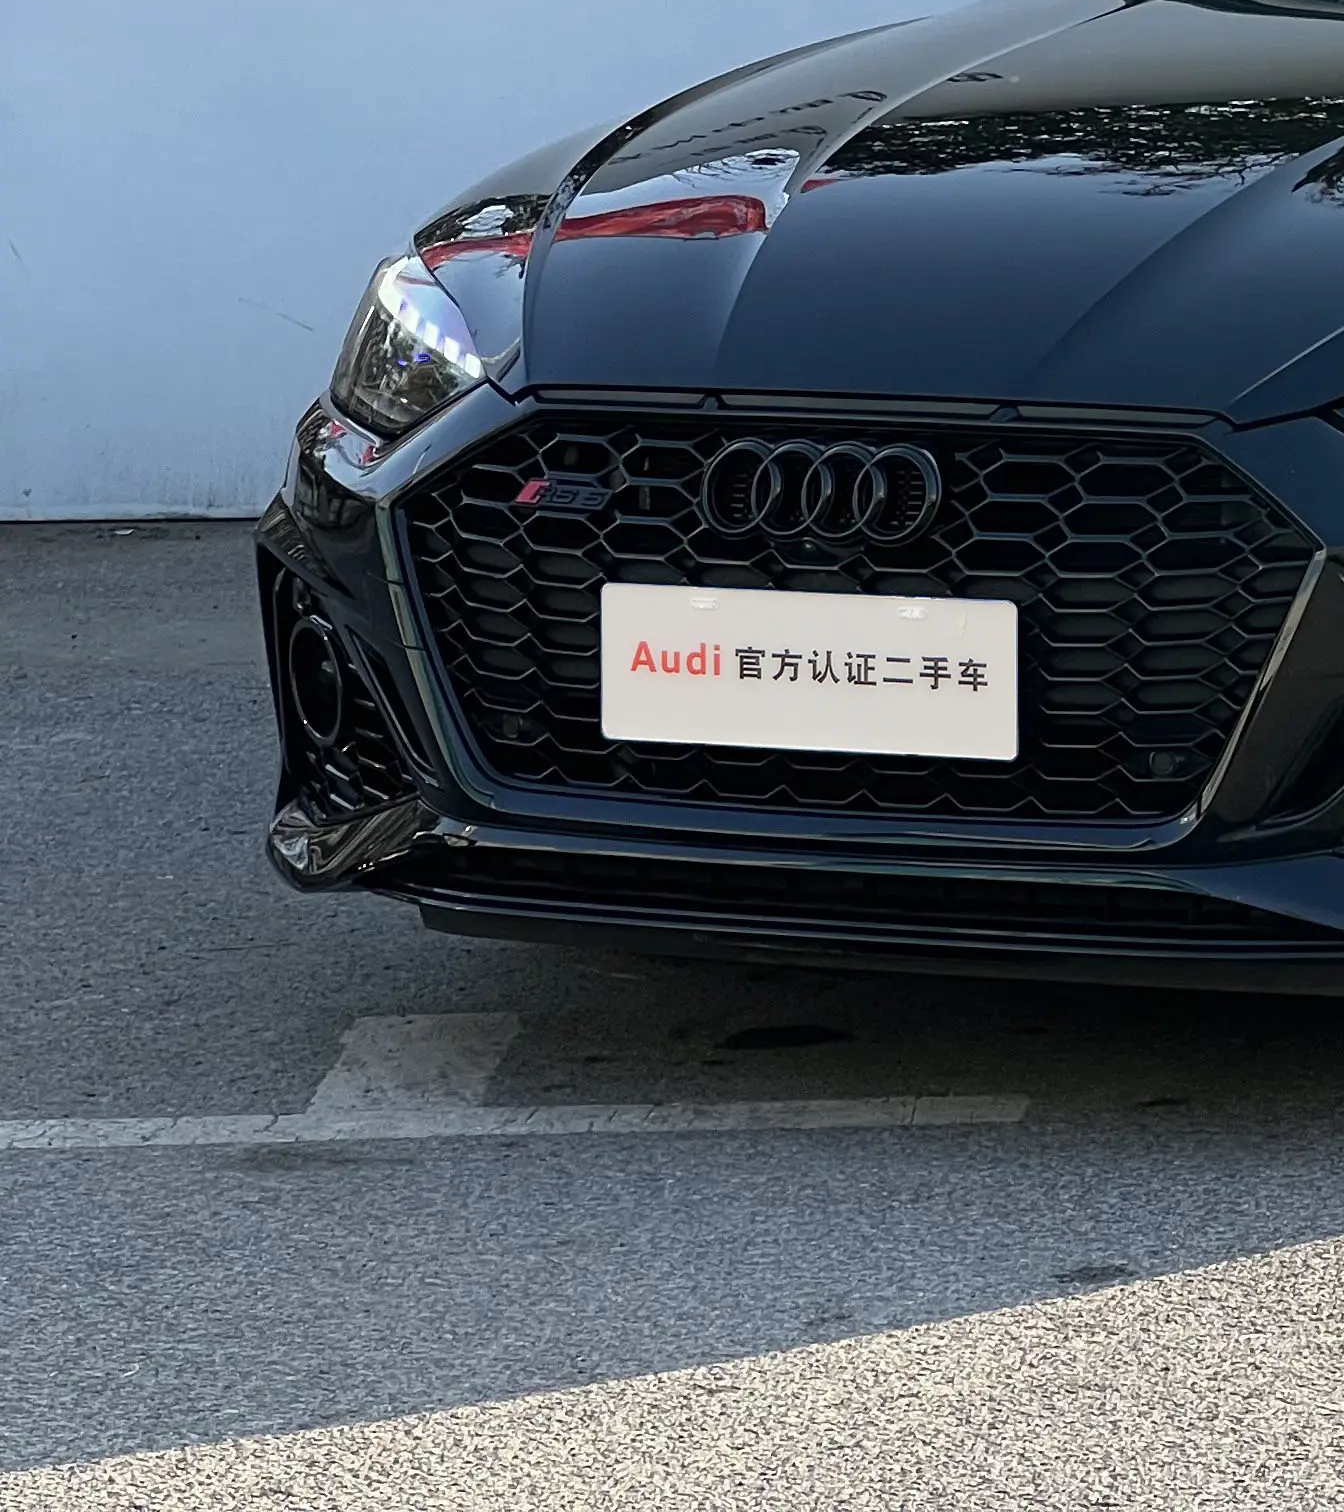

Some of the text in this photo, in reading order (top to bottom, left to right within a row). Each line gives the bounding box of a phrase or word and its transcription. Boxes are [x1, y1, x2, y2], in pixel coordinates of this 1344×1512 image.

[630, 640, 989, 693] Audi 官方认证二手车
